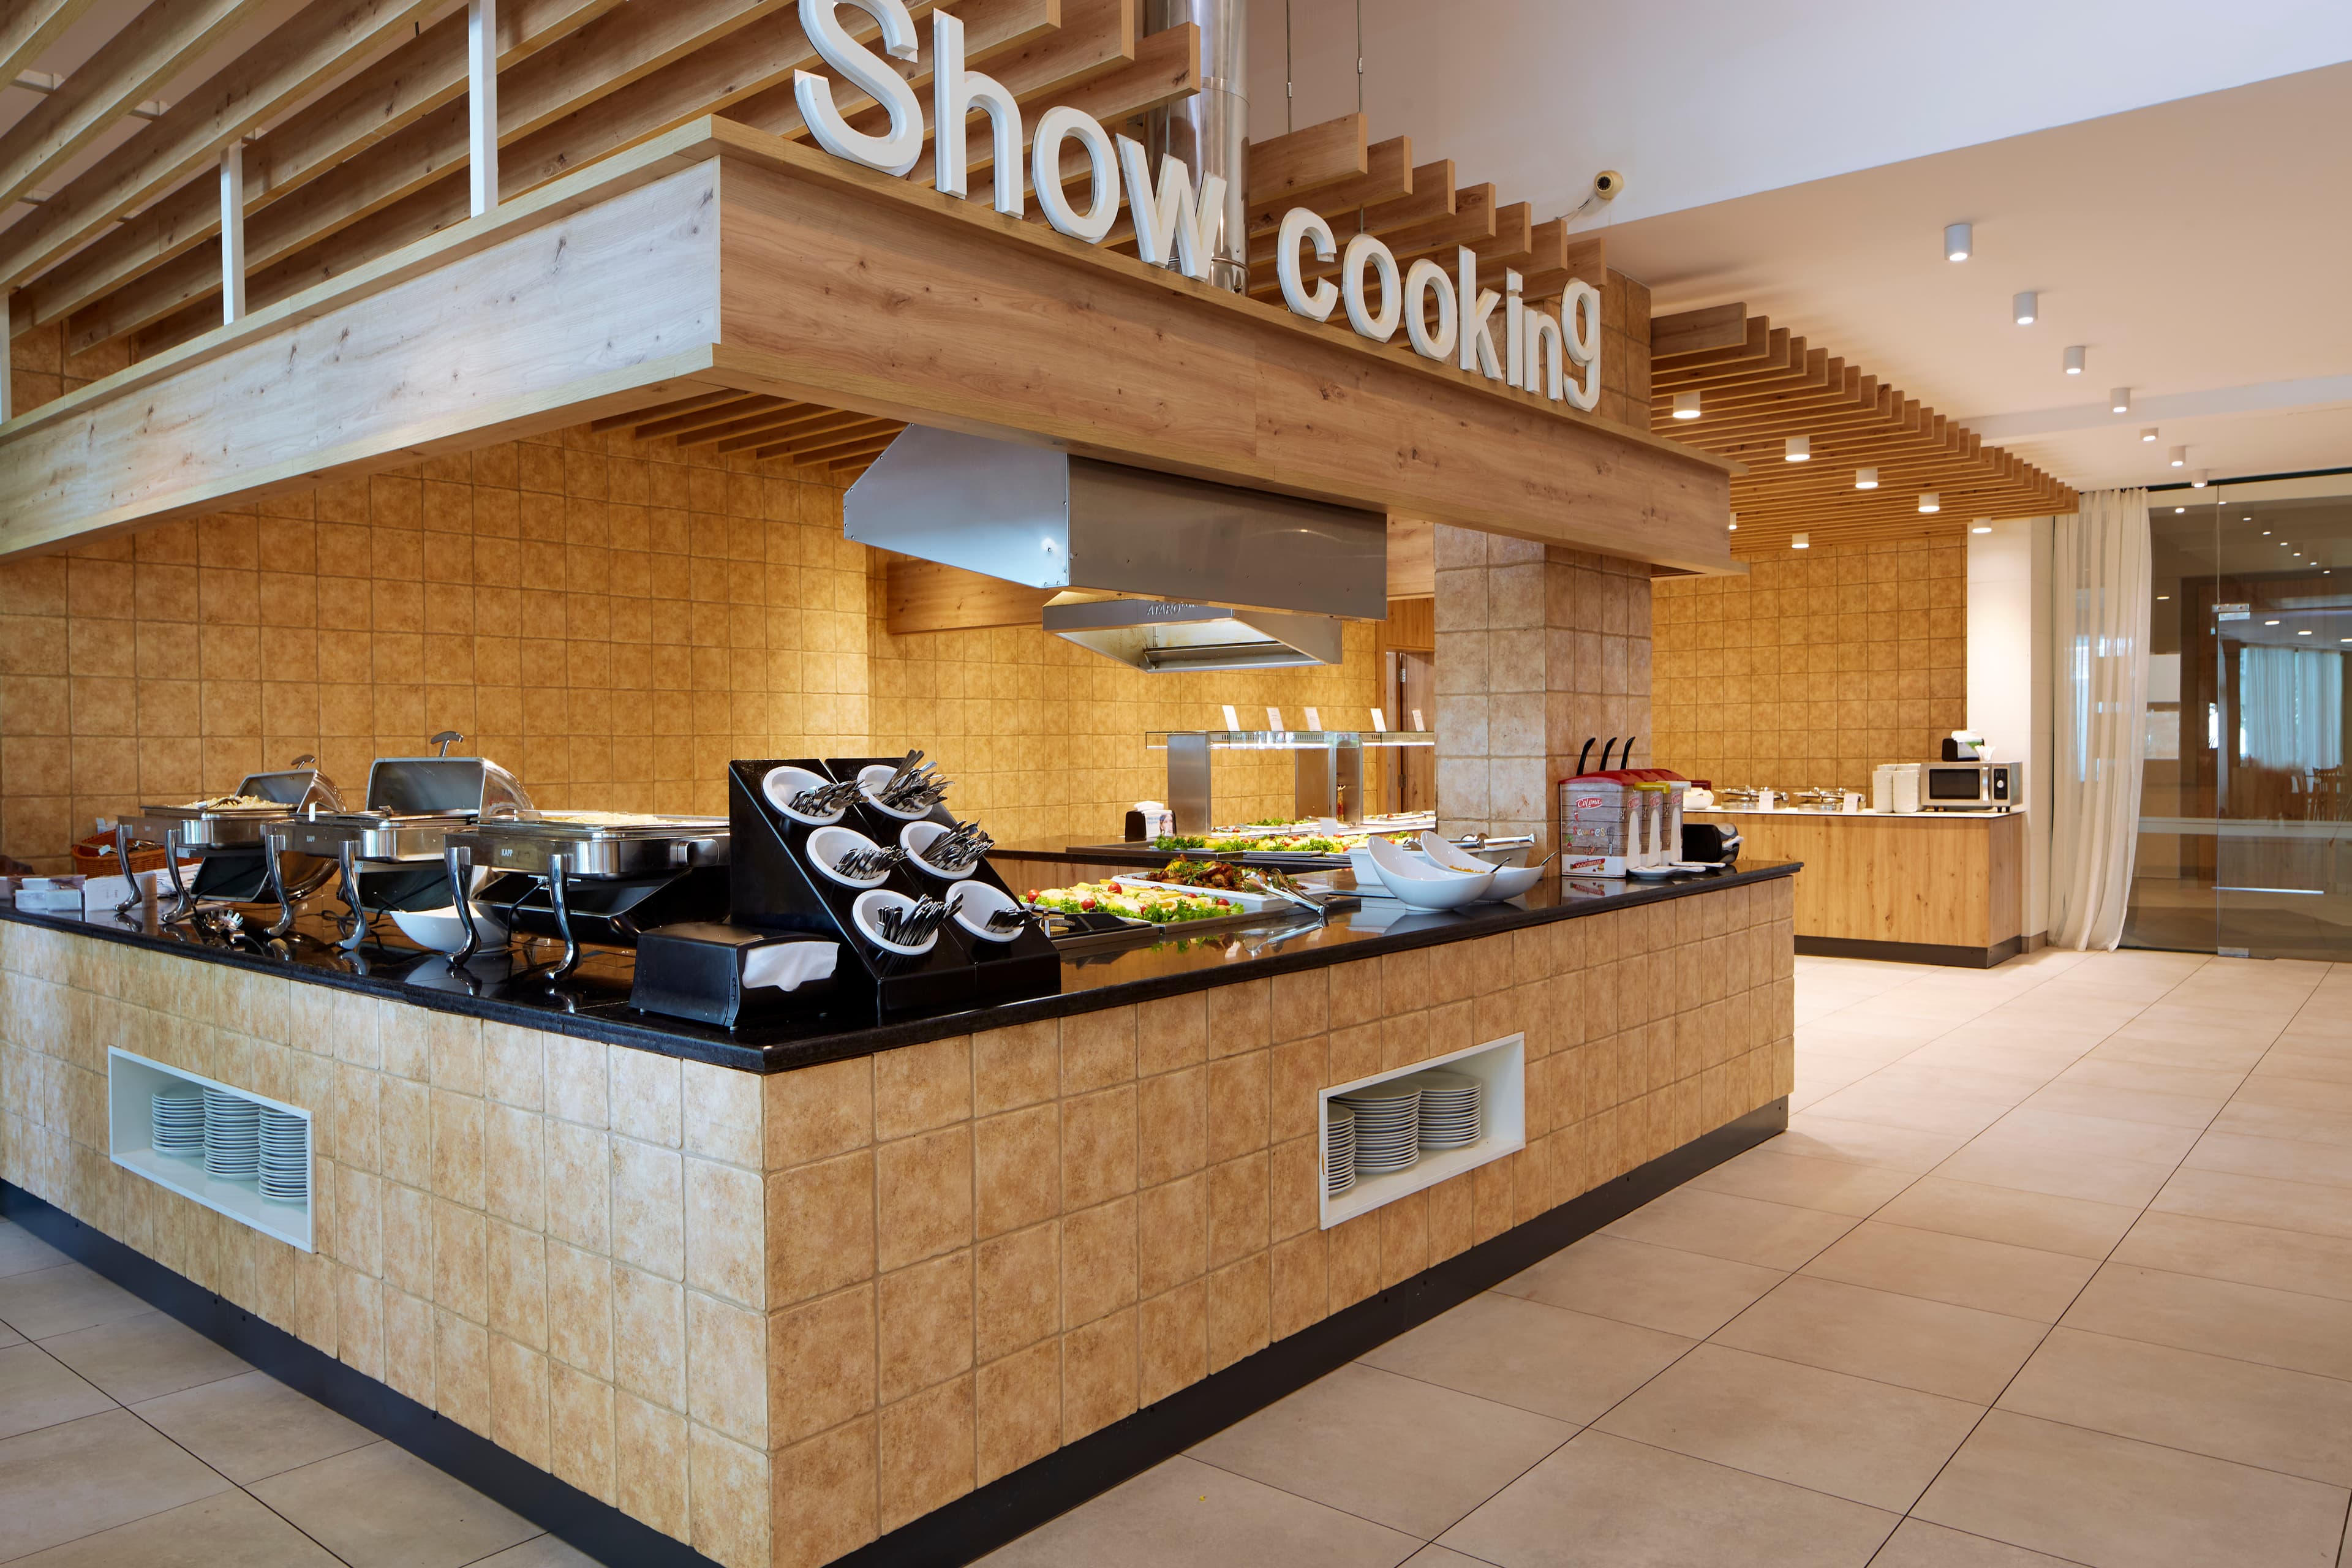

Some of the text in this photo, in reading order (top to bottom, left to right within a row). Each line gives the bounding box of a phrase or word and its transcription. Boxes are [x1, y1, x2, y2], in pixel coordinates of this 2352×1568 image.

[794, 0, 1600, 412] Show cooking
[1147, 603, 1181, 616] ATARO
[1577, 797, 1602, 808] Colona
[1572, 826, 1605, 837] Sauces
